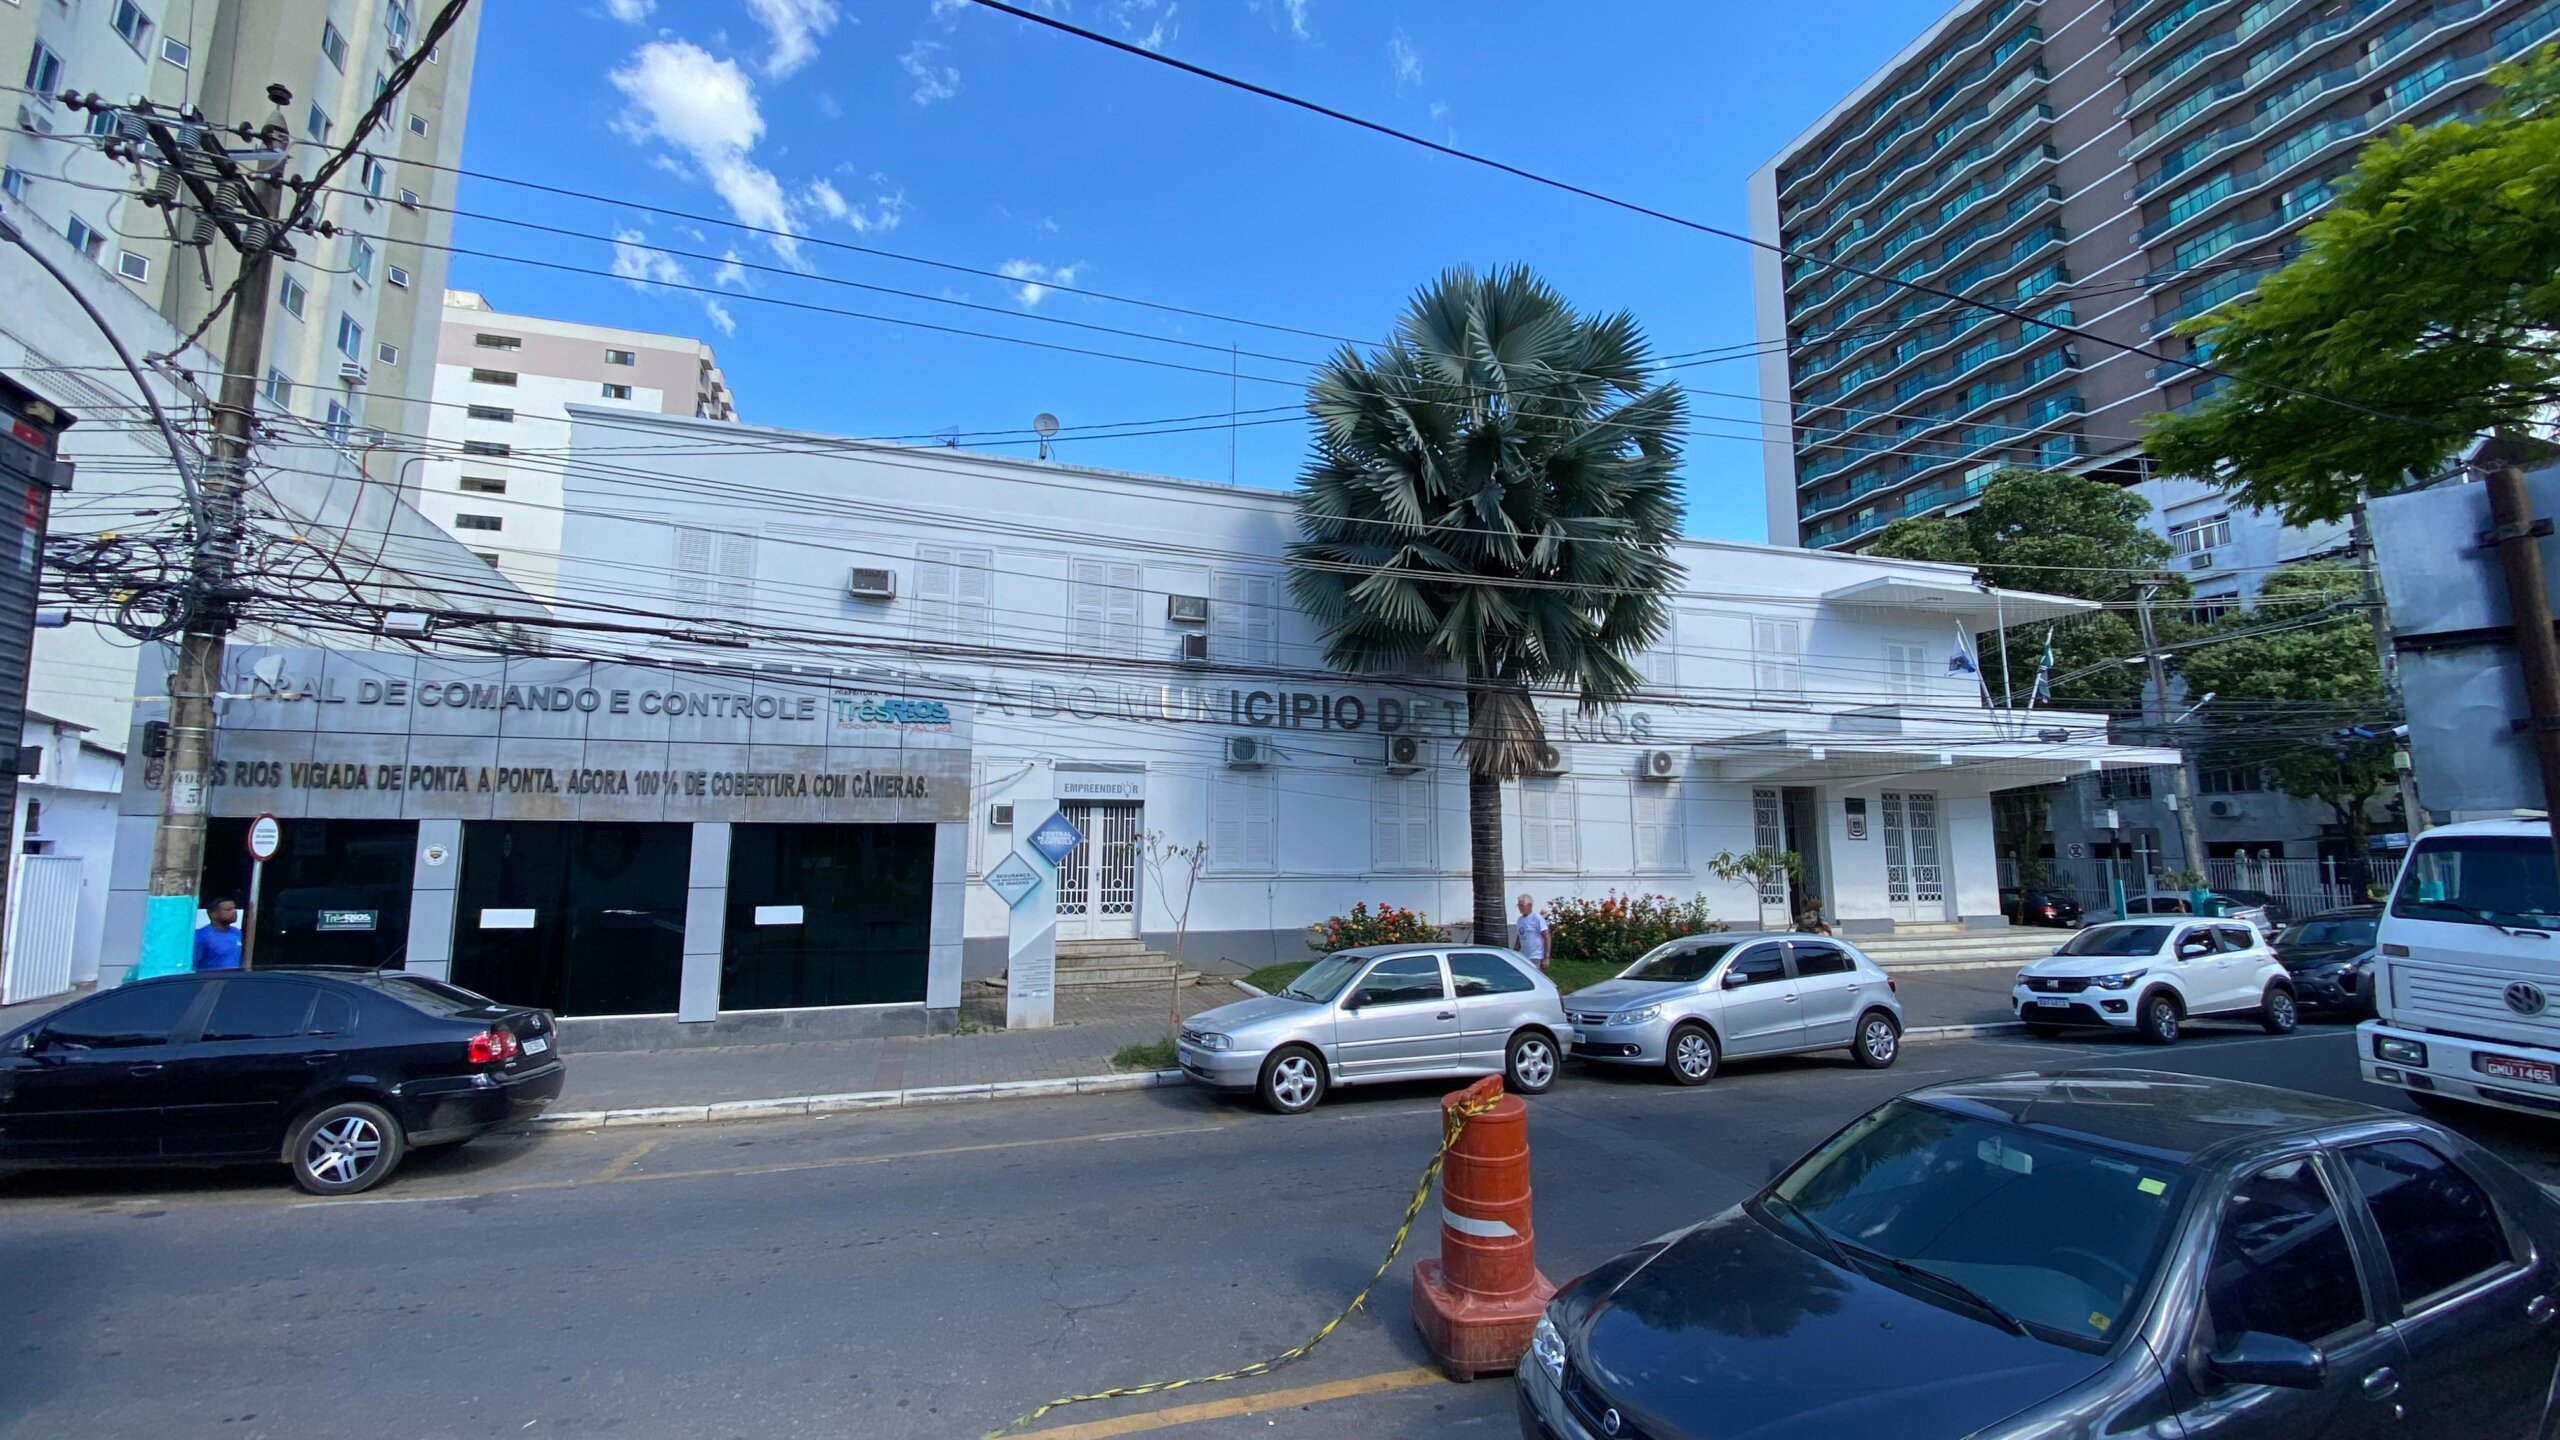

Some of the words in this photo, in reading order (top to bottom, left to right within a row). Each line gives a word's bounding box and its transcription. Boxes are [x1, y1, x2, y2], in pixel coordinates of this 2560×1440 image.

[357, 677, 408, 706] DE
[417, 681, 601, 713] COMANDO
[609, 689, 631, 715] E
[638, 688, 816, 721] CONTROLE
[233, 760, 282, 789] RIOS
[290, 762, 369, 791] VIGIADA
[378, 764, 403, 792] DE
[409, 764, 469, 793] PONTA
[476, 766, 491, 793] A
[567, 767, 629, 796] AGORA
[685, 770, 707, 797] DE
[711, 771, 808, 799] COBERTURA
[813, 773, 847, 799] COM
